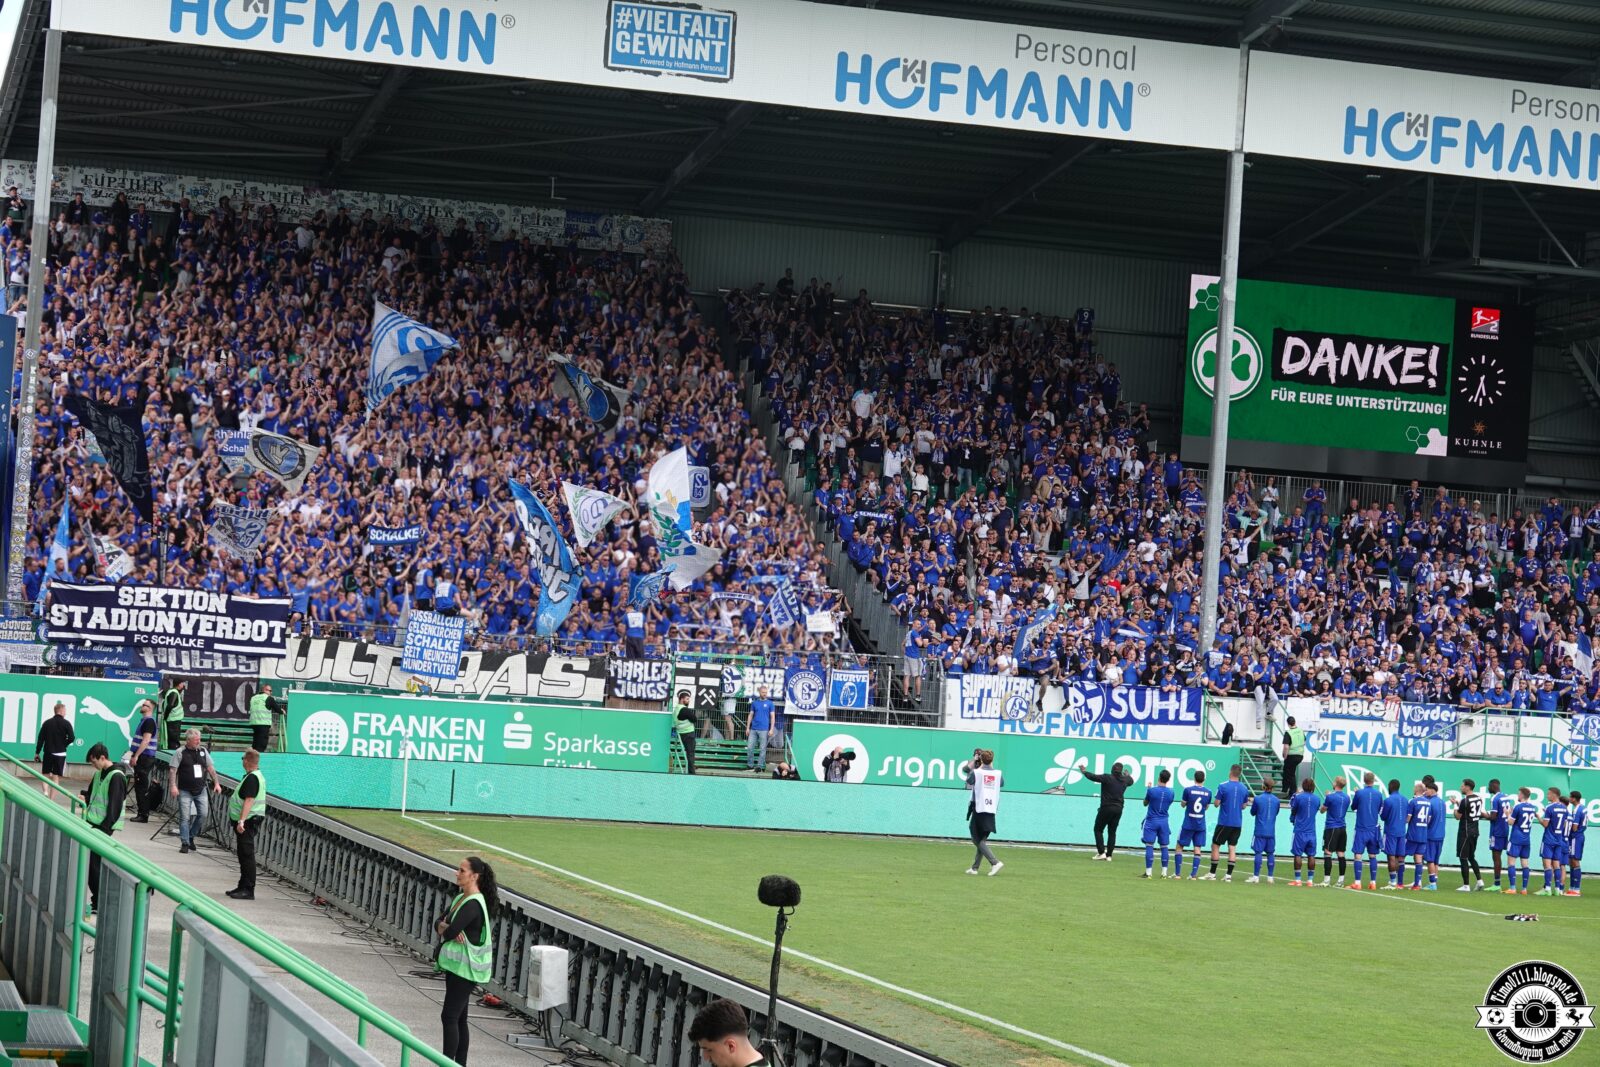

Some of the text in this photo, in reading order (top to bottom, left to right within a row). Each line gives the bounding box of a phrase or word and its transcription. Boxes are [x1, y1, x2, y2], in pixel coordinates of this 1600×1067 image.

[615, 6, 728, 39] #VIELFALT
[615, 30, 726, 63] GEWINNT
[1015, 33, 1137, 72] Personal
[640, 57, 725, 73] Powered by Hofmann Personal
[835, 50, 1134, 132] HOFMANN
[1489, 320, 1499, 332] 2
[1470, 333, 1499, 341] BUNDESLIGA
[1280, 335, 1440, 389] DANKE!
[1271, 389, 1447, 416] FÜR EURE UNTERSTÜTZUNG!
[1454, 437, 1502, 449] KUHNLE
[369, 527, 420, 541] SCHALKE
[117, 585, 228, 613] SEKTION
[50, 603, 287, 643] STADIONVERBOT
[408, 621, 463, 640] GELSENKIRCHEN
[134, 634, 205, 648] FC SCHALKE
[405, 632, 461, 652] SCHALKE
[403, 644, 459, 664] SEIT NEUNZEHN
[402, 657, 456, 676] HUNDERTVIER
[744, 666, 785, 684] BLUE
[614, 679, 670, 700] JUNGS
[962, 674, 1034, 699] SUPPORTERS
[962, 698, 1001, 718] CLUB
[1109, 686, 1198, 722] SUHL
[352, 711, 486, 741] FRANKEN
[543, 731, 652, 757] Sparkasse
[1304, 728, 1430, 757] OFMANN
[1193, 796, 1203, 813] 6
[1469, 800, 1482, 818] 32
[1557, 813, 1564, 830] 7
